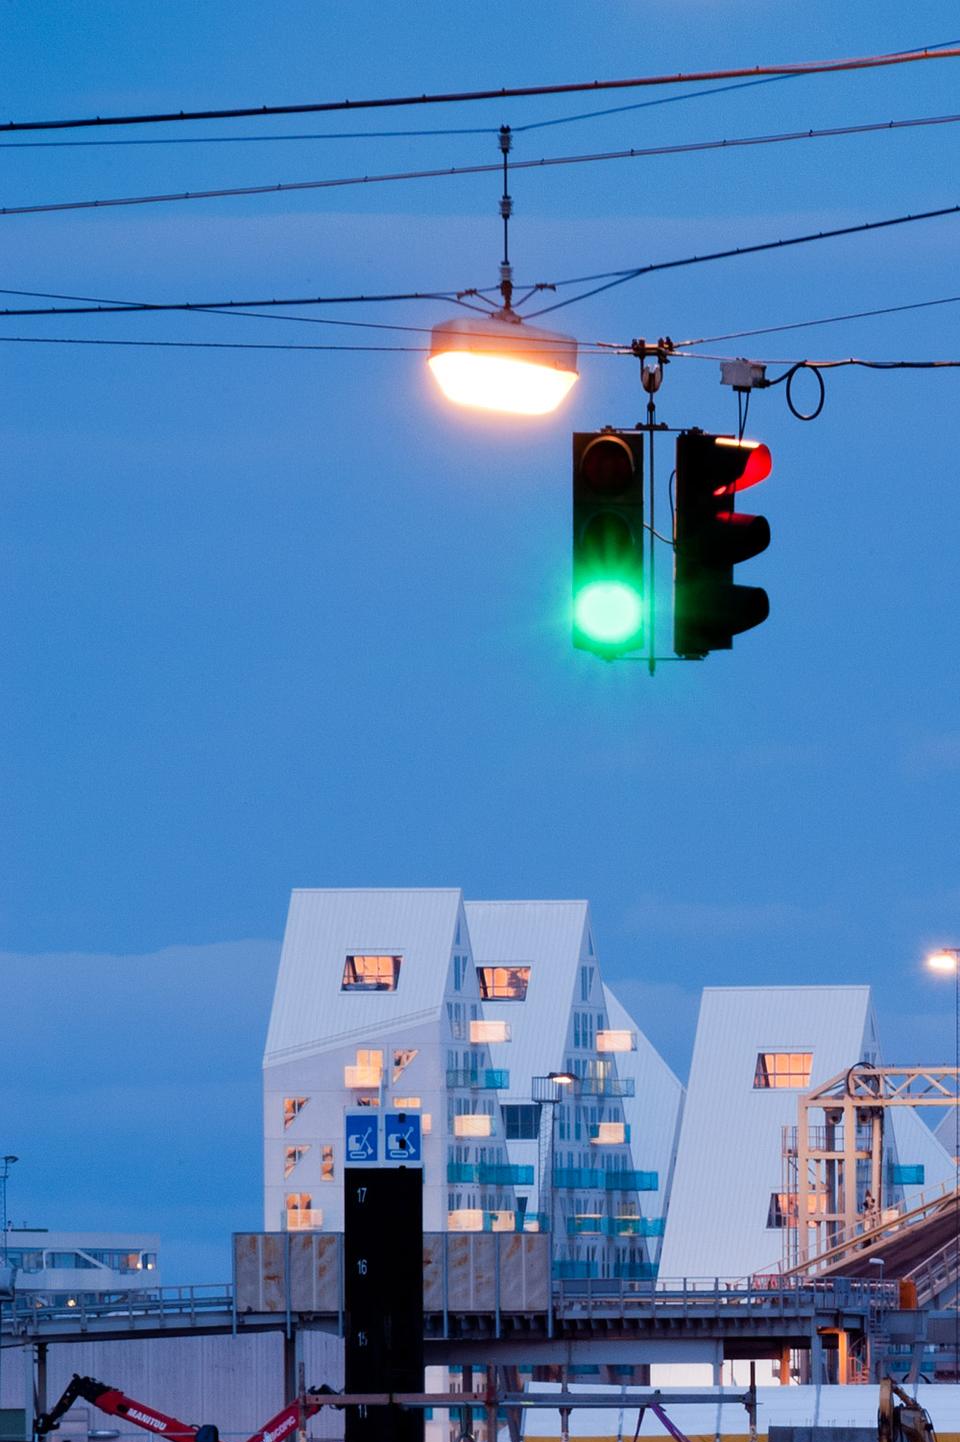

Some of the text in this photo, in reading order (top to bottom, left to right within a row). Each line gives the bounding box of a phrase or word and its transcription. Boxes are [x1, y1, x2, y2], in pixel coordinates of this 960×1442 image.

[357, 1187, 367, 1203] 17
[357, 1259, 368, 1275] 16
[358, 1331, 368, 1347] 15
[127, 1408, 167, 1431] MANITOU
